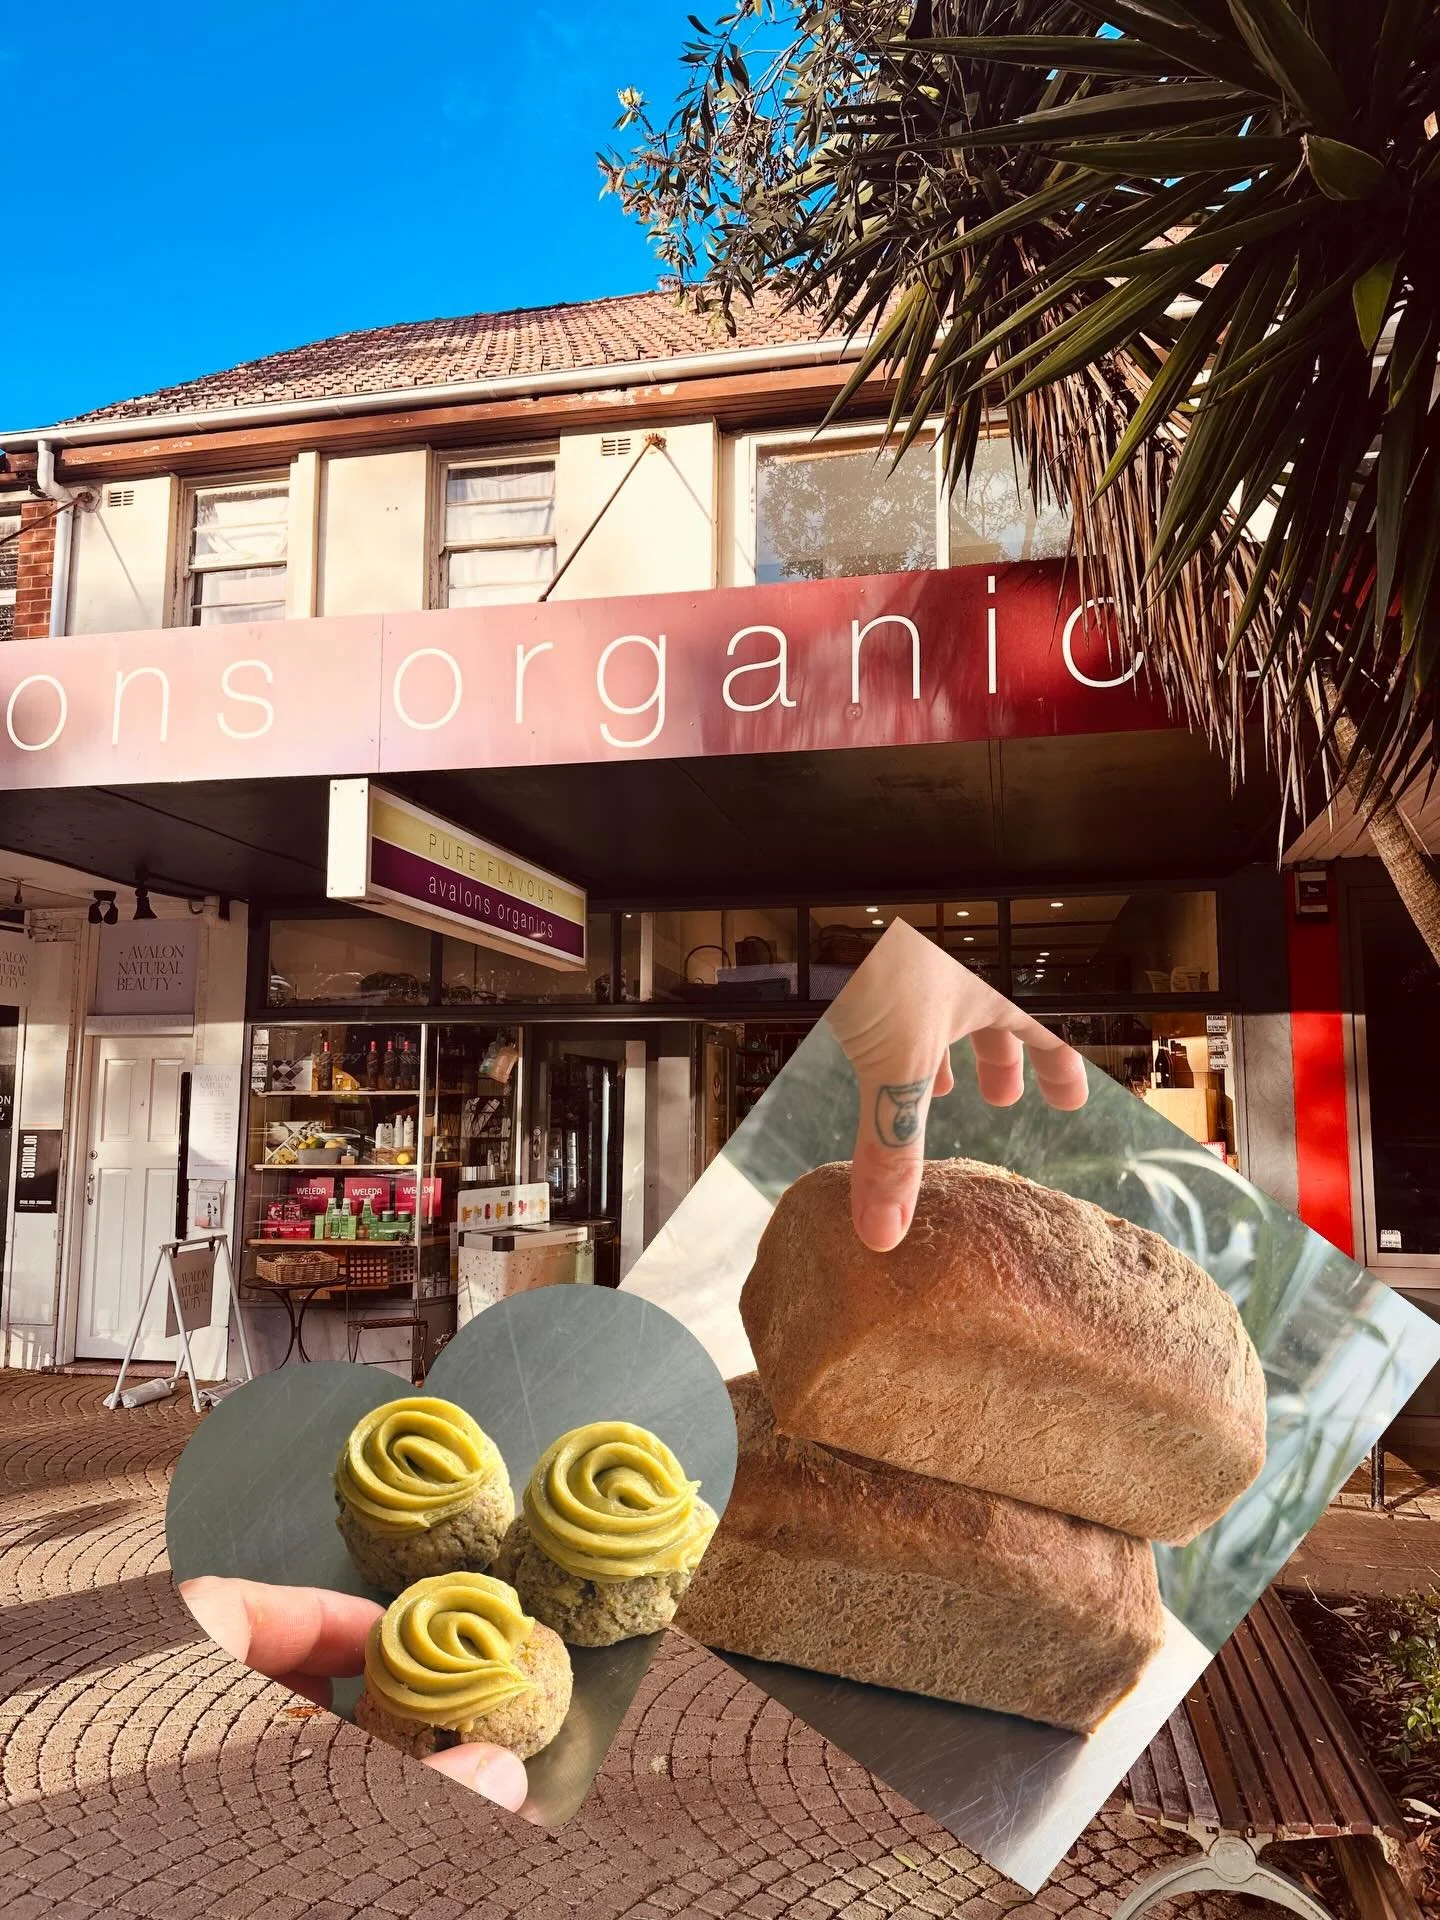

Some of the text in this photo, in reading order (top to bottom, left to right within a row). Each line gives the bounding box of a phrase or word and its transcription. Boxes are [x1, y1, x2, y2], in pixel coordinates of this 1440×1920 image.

[392, 575, 1282, 749] organic
[428, 832, 555, 905] PURE FLAVOUR
[428, 875, 554, 939] avalons organics
[128, 945, 185, 959] AVALON
[118, 961, 184, 975] NATURAL
[116, 977, 170, 991] BEAUTY
[296, 1187, 326, 1196] WELEDA
[351, 1187, 383, 1197] WELEDA
